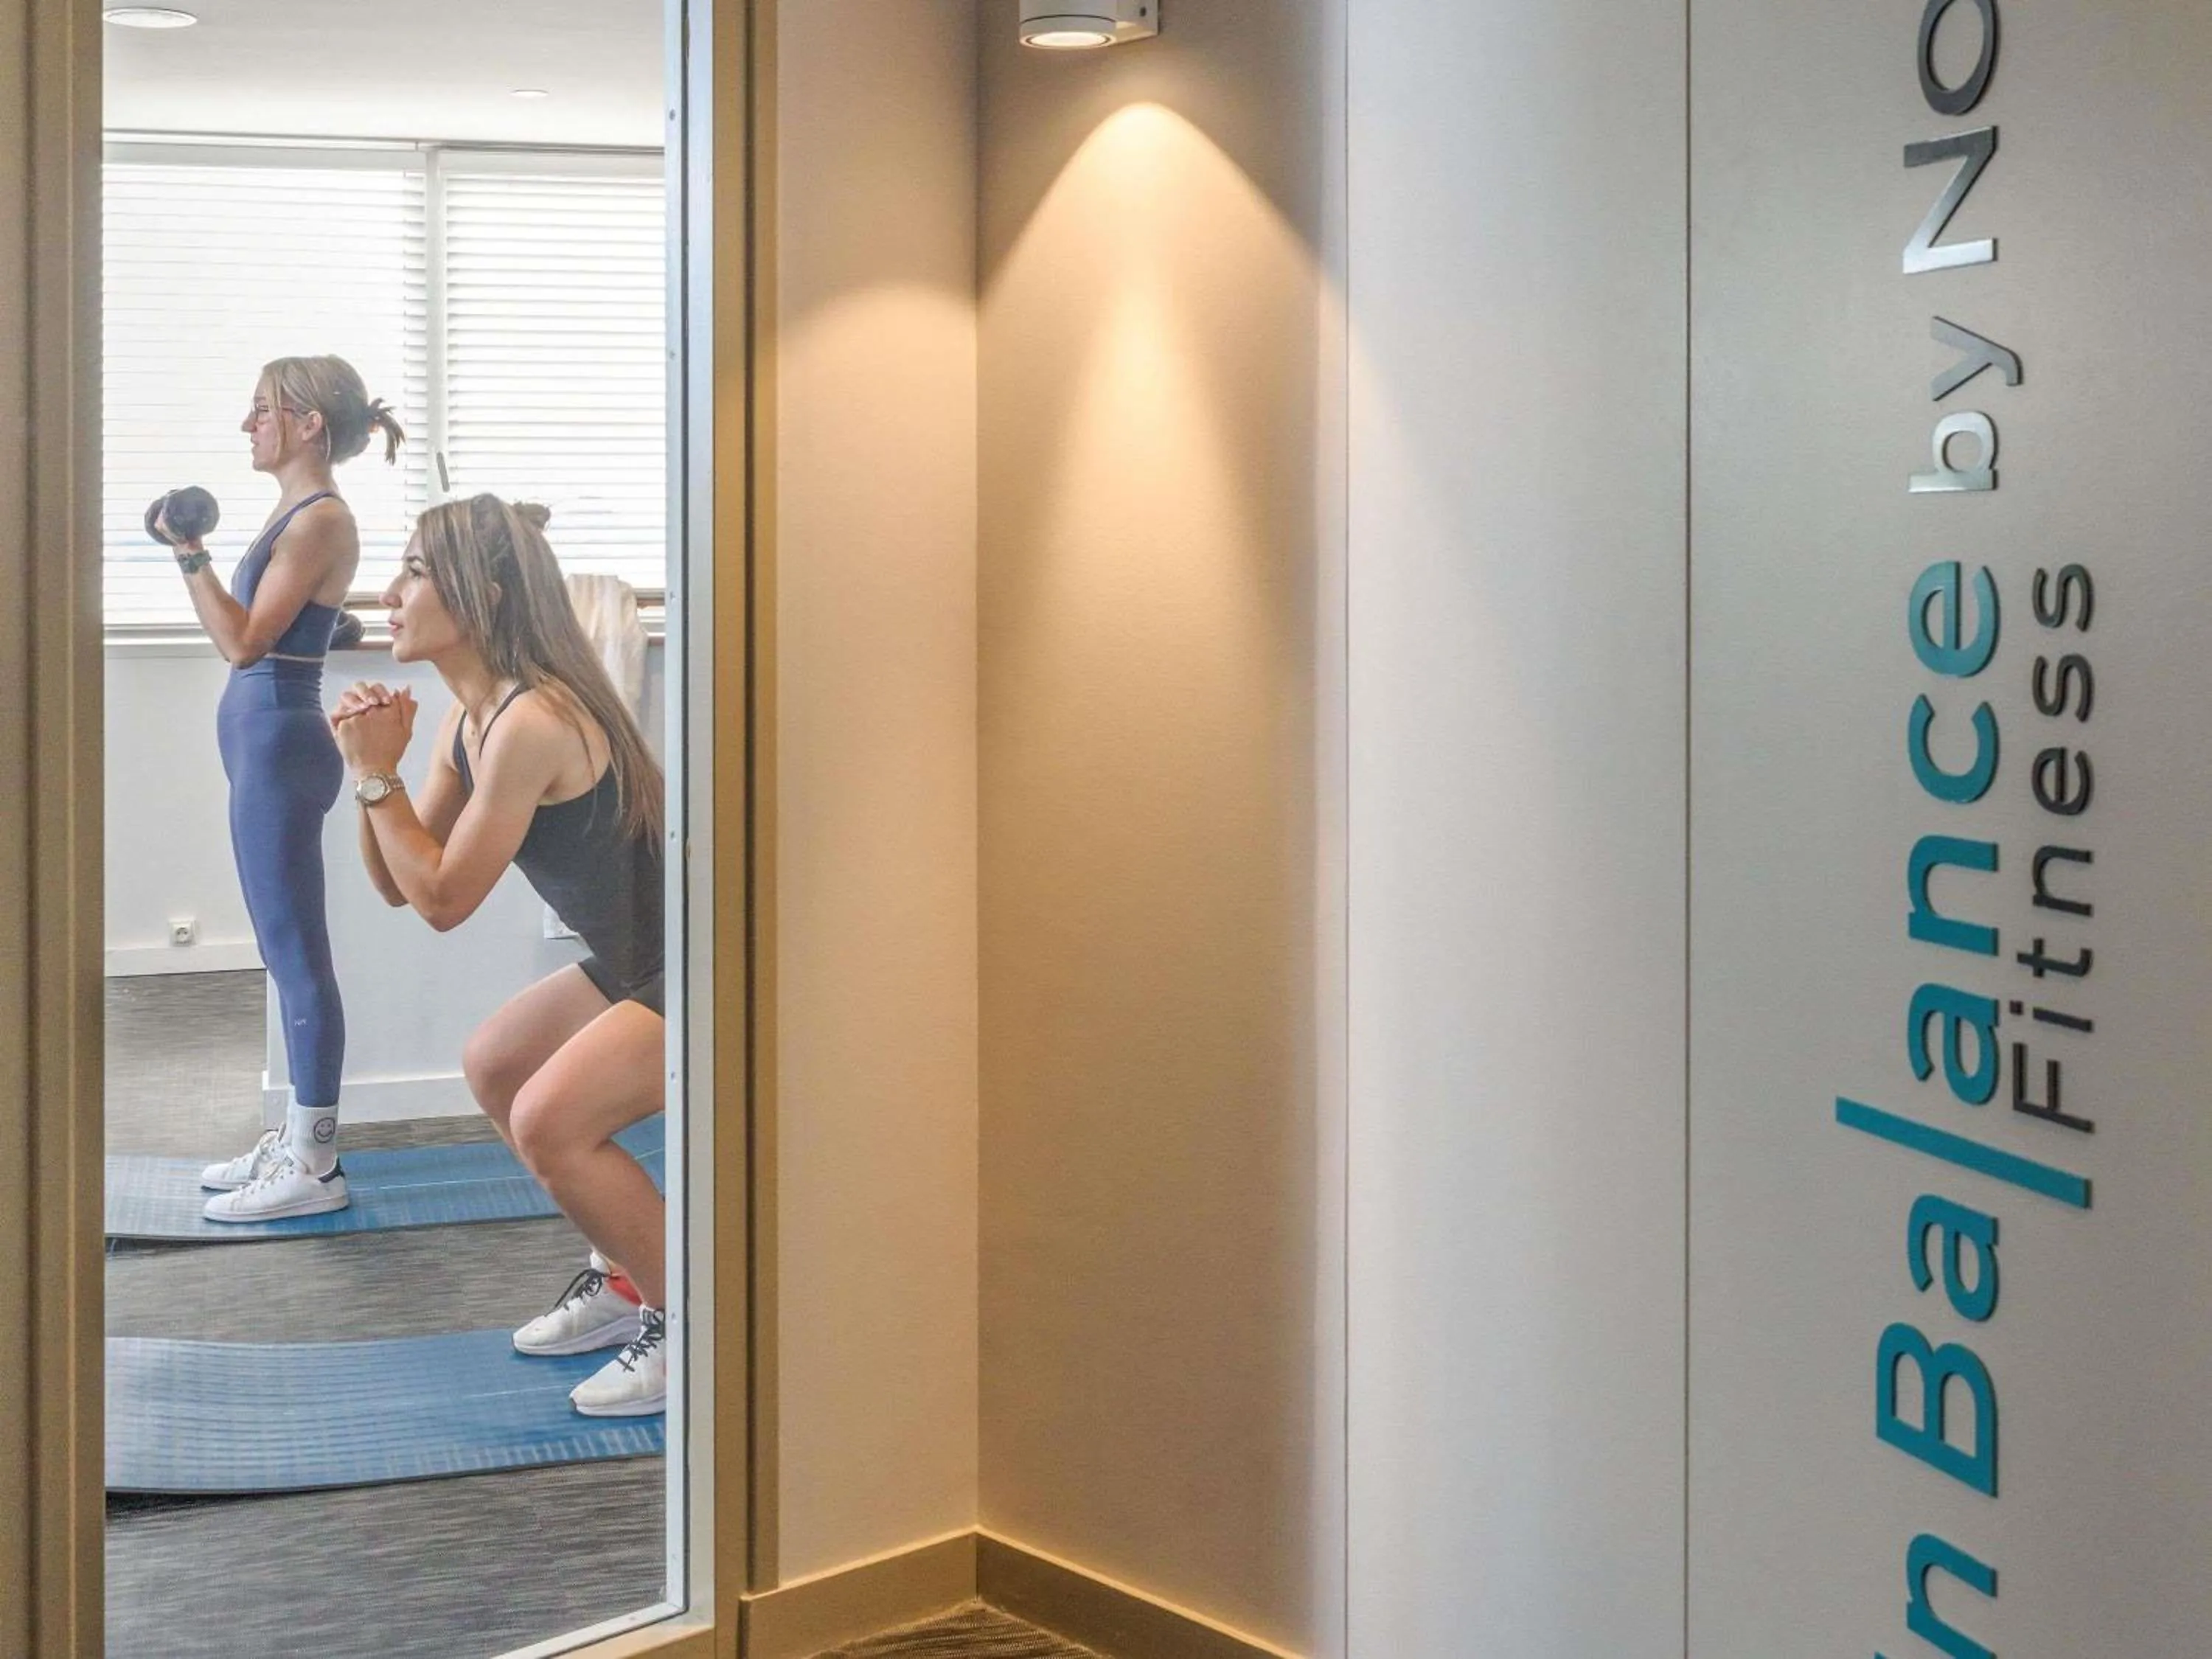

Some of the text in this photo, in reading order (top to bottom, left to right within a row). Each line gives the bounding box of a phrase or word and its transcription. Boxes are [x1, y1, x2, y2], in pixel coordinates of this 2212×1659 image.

[1902, 0, 2000, 274] NO
[1908, 316, 2023, 492] by
[2013, 563, 2094, 1133] Fitness
[1874, 1533, 1997, 1659] n
